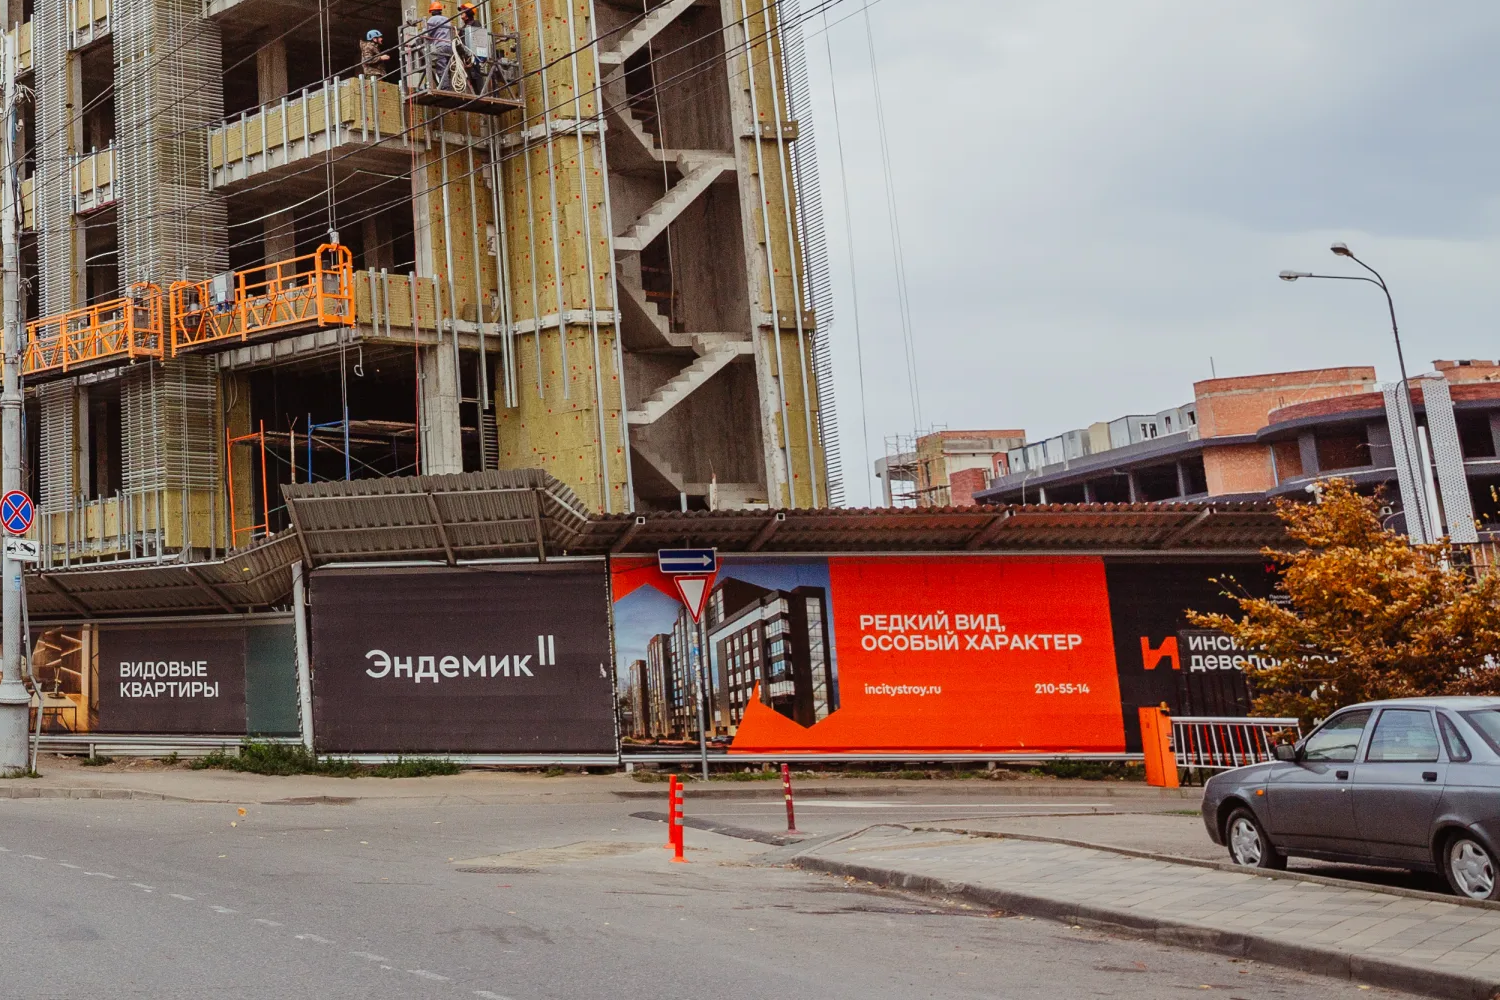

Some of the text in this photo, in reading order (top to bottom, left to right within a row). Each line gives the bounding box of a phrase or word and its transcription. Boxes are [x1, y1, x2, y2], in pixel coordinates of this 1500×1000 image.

[860, 610, 1006, 633] РЕДКИЙ ВИД,
[861, 630, 1082, 651] ОСОБЫЙ ХАРАКТЕР
[120, 661, 208, 680] ВИДОВЫЕ
[365, 648, 535, 683] Эндемик
[120, 681, 219, 698] КВАРТИРЫ
[864, 683, 942, 697] incitystroy.ru
[1034, 683, 1090, 694] 210-55-14
